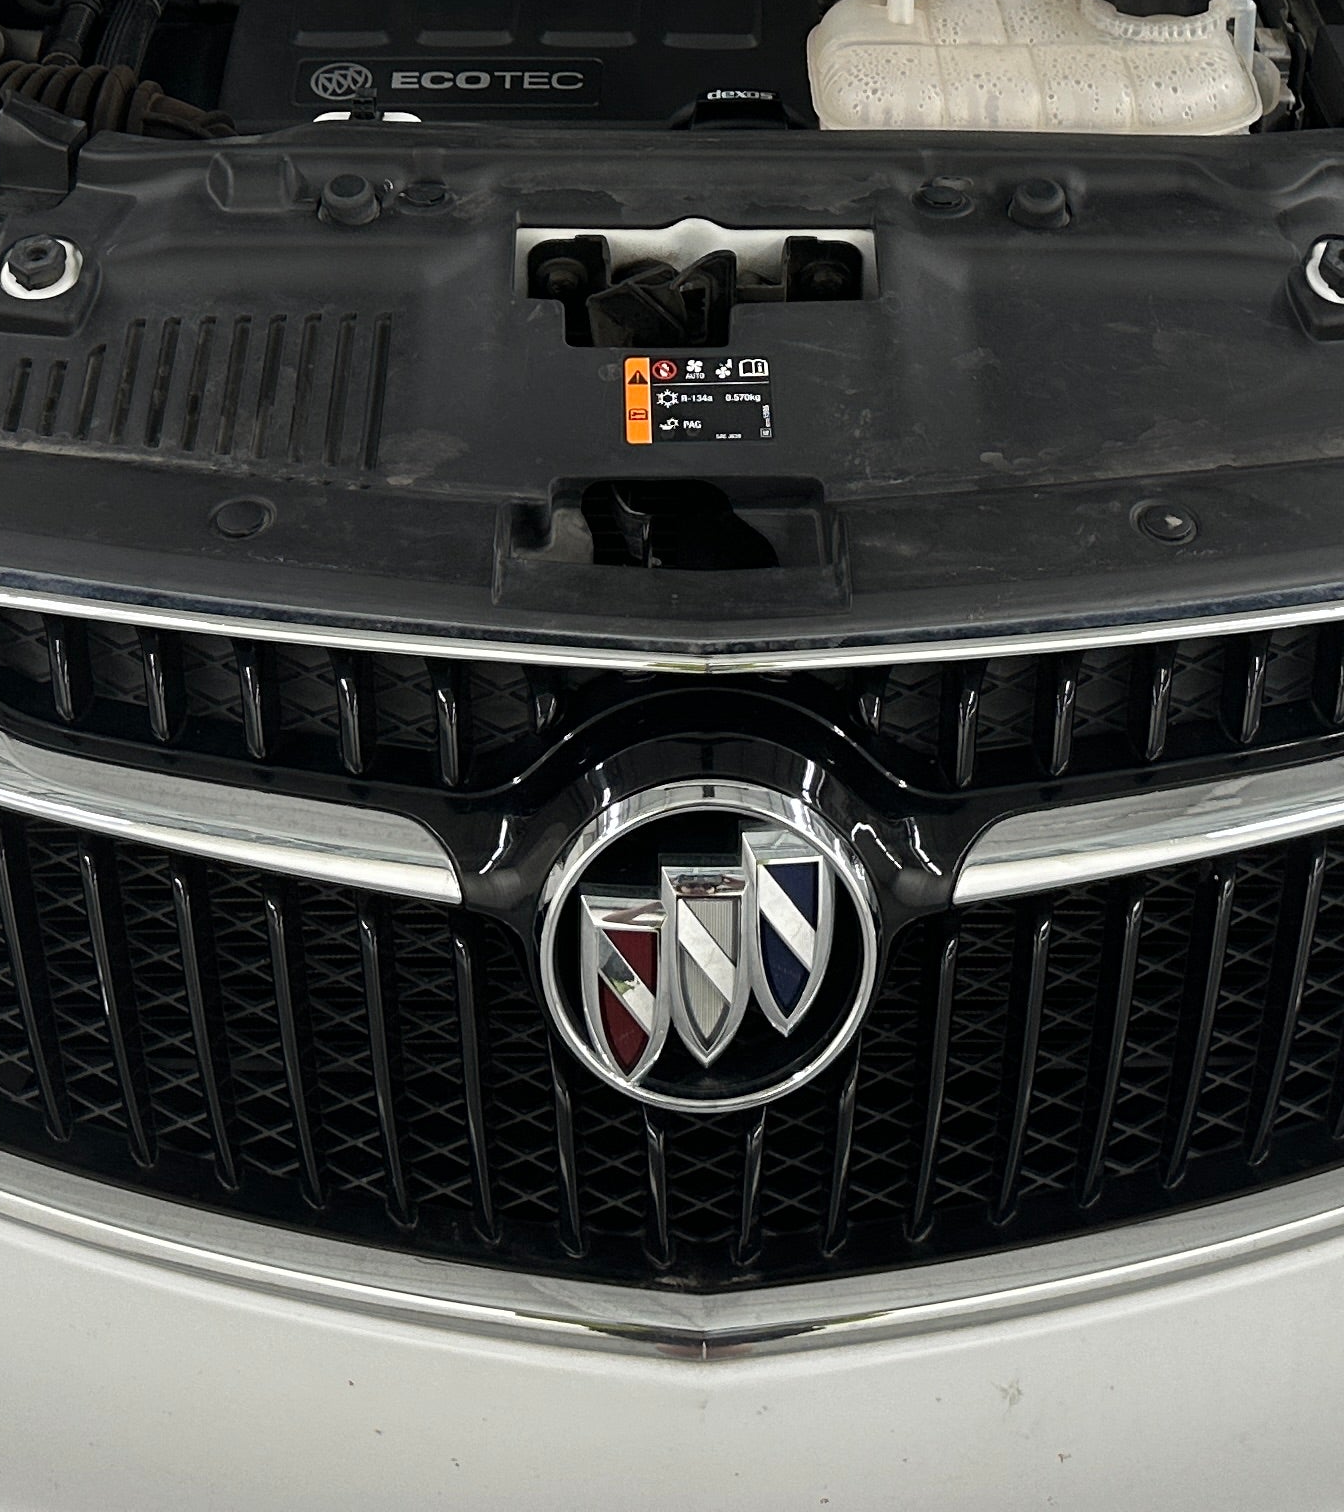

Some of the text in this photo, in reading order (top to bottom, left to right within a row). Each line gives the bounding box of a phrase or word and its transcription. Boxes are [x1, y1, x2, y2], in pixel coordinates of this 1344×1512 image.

[391, 71, 584, 90] ECOTEC
[706, 89, 774, 100] dexos
[685, 372, 705, 380] AUTO
